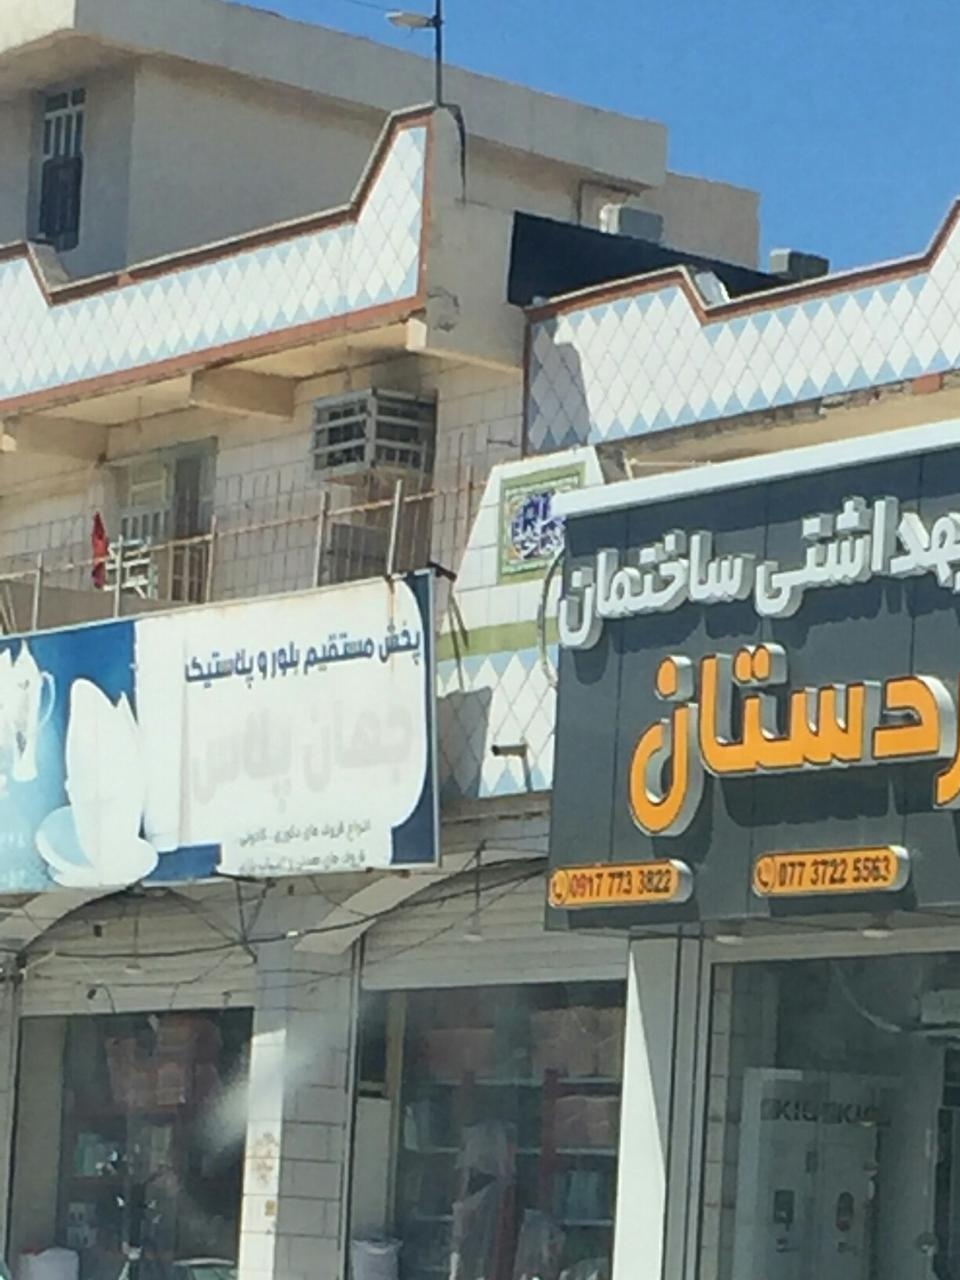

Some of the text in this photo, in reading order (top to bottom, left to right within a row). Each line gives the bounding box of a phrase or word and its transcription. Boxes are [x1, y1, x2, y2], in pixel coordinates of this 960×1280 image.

[558, 529, 757, 650] ساختمان
[184, 622, 421, 690] پخش مستقیم بلور و پلاستیک
[570, 872, 604, 898] 0917
[607, 870, 633, 896] 773
[779, 860, 806, 887] 077
[810, 857, 848, 885] 3722
